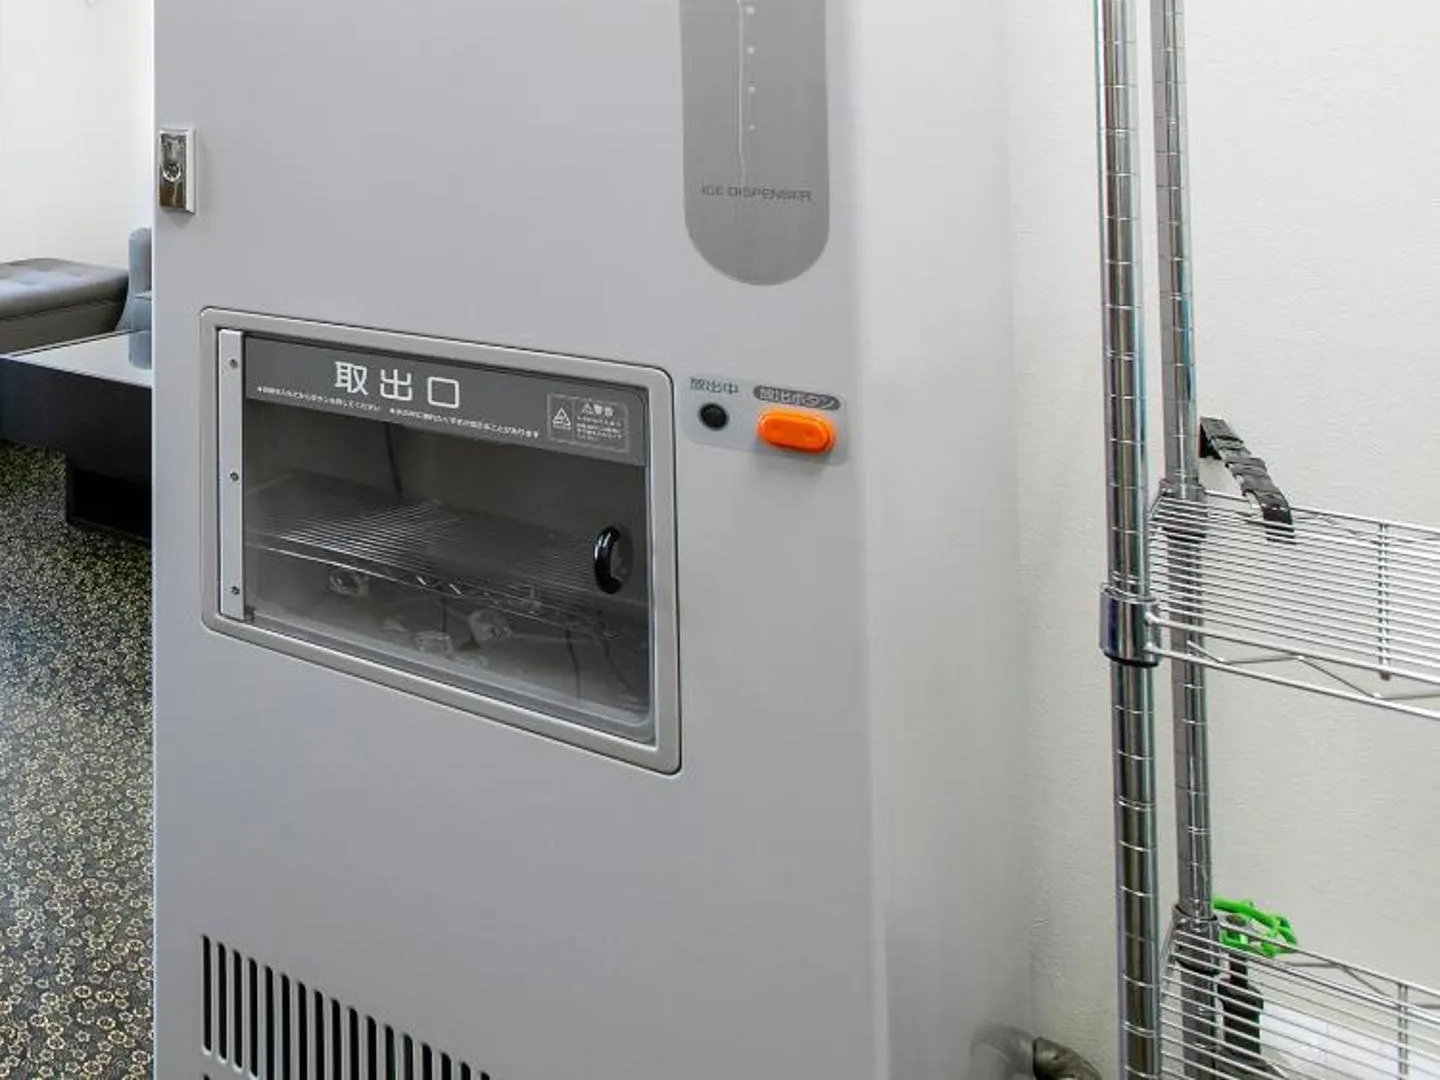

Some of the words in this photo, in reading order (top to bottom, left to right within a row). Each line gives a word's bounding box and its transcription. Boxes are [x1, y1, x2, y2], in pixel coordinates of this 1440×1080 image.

[701, 184, 724, 196] ICE
[727, 185, 812, 203] DISPENSER
[333, 359, 460, 410] 取出口
